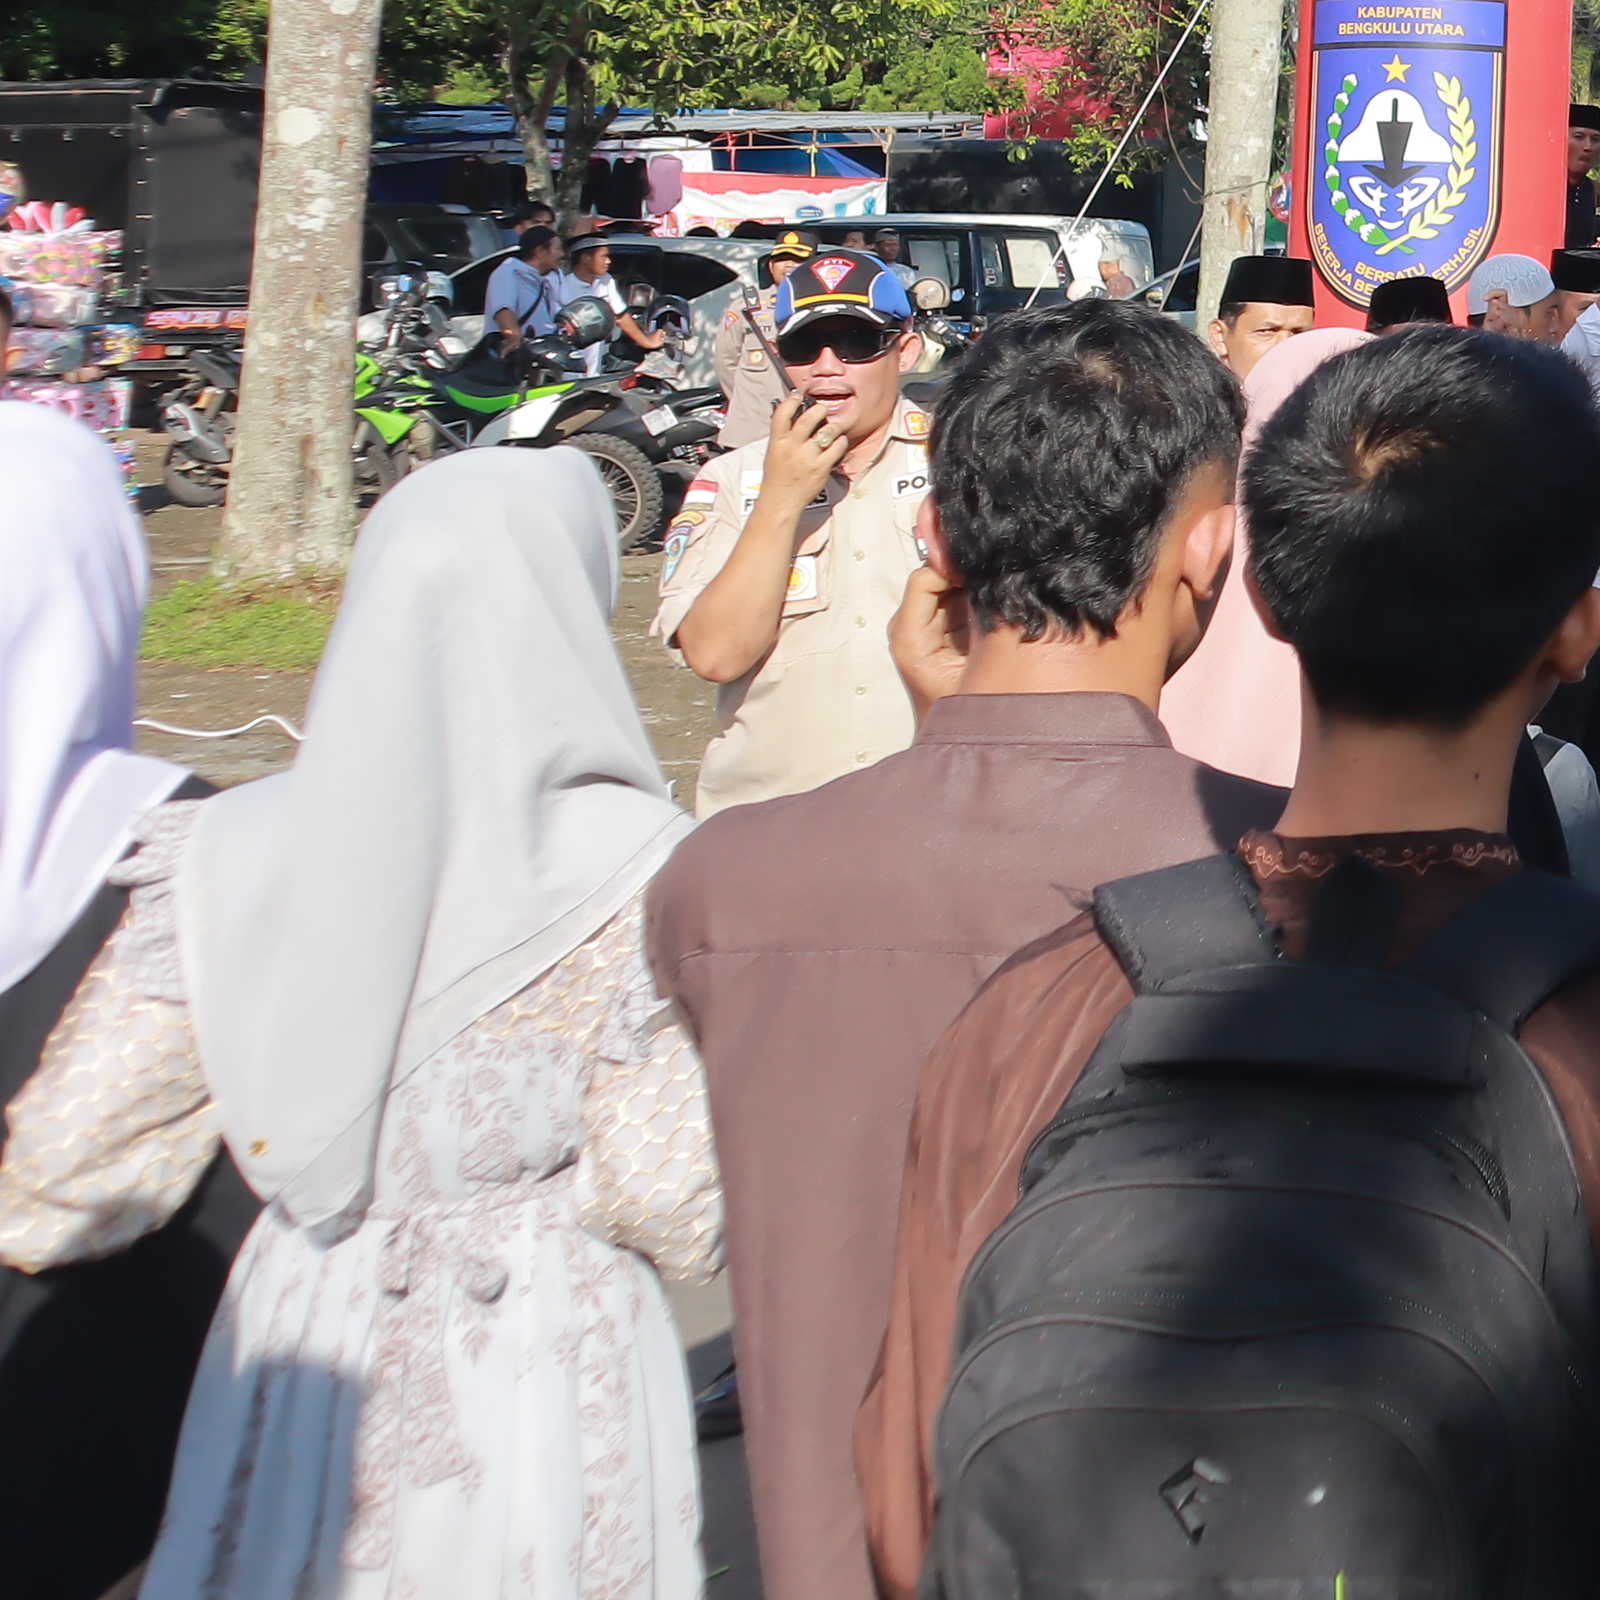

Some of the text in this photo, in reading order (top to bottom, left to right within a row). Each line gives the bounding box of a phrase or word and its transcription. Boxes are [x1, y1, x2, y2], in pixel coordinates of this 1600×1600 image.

[1357, 6, 1442, 20] KABUPATEN
[1338, 22, 1464, 37] BENGKULU UTARA
[1314, 223, 1483, 286] BEKERJA ERHASIL
[1354, 261, 1427, 283] BERSATU
